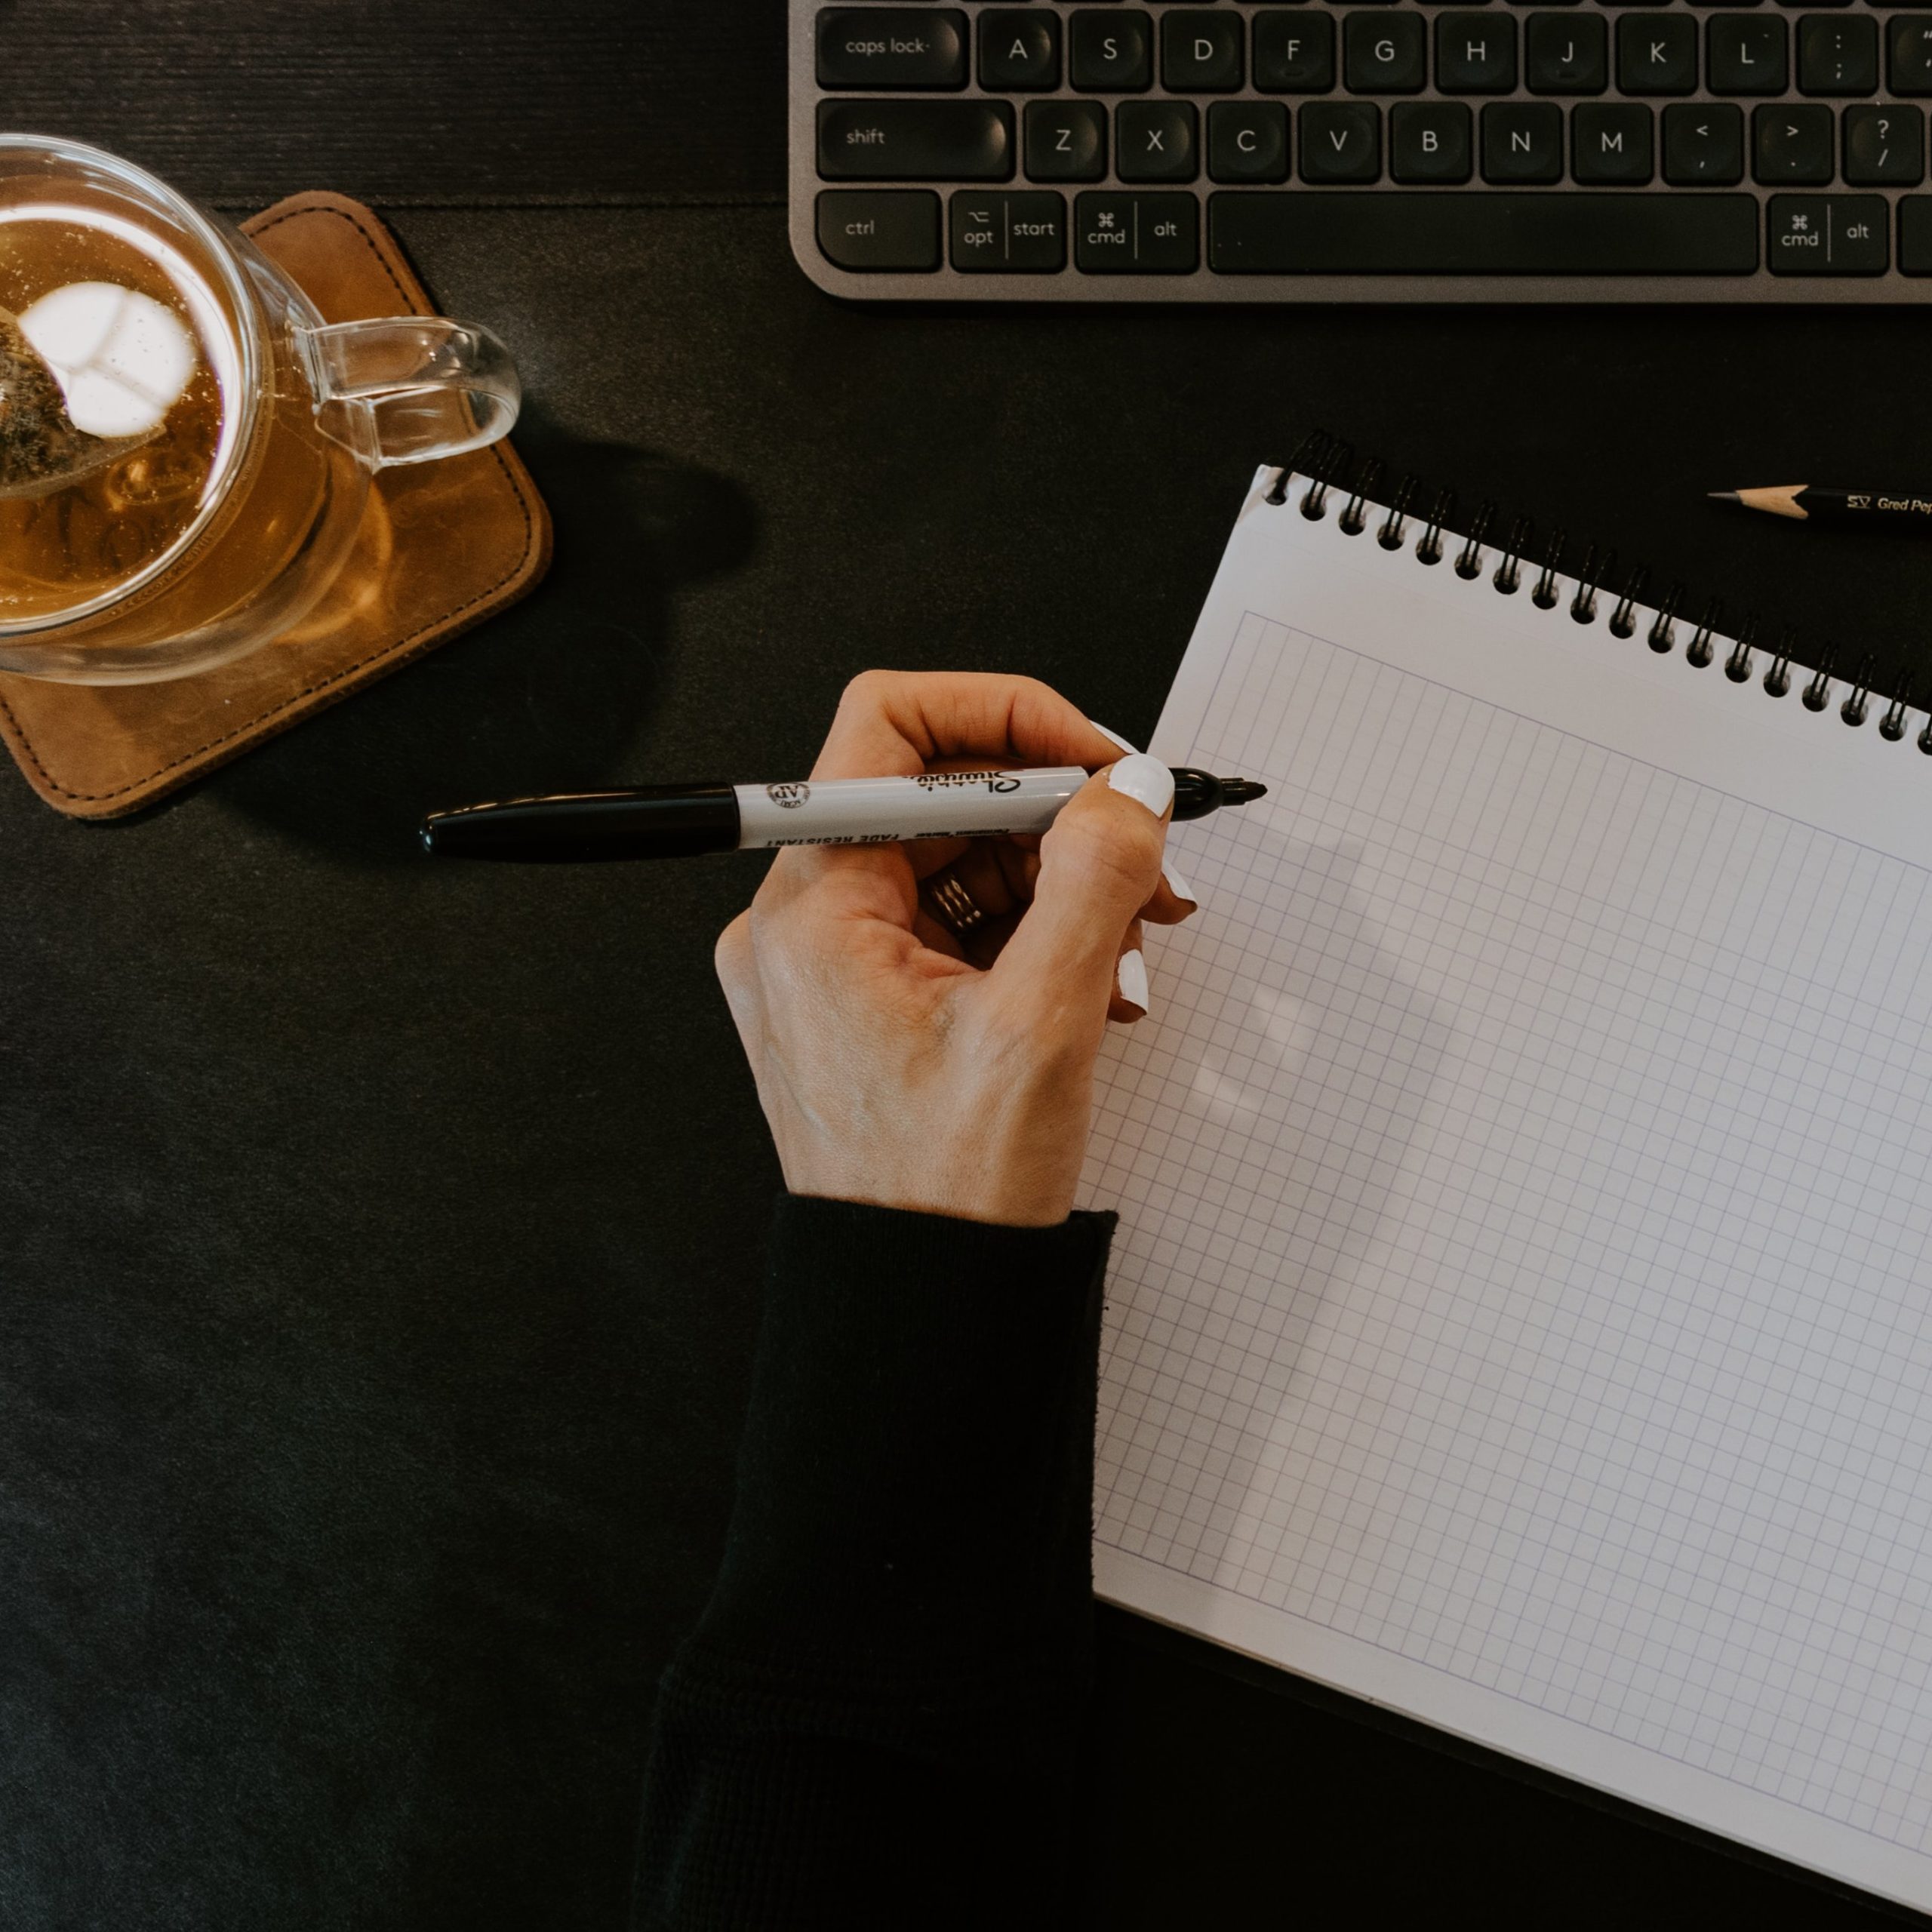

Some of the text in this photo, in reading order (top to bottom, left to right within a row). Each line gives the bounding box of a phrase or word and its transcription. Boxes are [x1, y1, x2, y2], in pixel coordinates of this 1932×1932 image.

[845, 38, 924, 57] caps lock
[1009, 38, 1028, 59] A
[1103, 38, 1118, 60] S
[1195, 39, 1214, 60] D
[1287, 39, 1300, 60] F
[1374, 40, 1395, 62] G
[1467, 41, 1485, 61] H
[1561, 42, 1574, 63] J
[1651, 42, 1666, 63] K
[1741, 43, 1755, 64] L
[847, 128, 884, 144] shift
[1055, 129, 1072, 151] Z
[1878, 119, 1889, 140] ?
[1147, 130, 1164, 151] X
[1237, 130, 1256, 152] C
[1330, 131, 1348, 151] V
[1423, 131, 1438, 152] B
[1512, 131, 1531, 152] N
[1601, 132, 1623, 152] M
[845, 220, 875, 235] ctrl
[1014, 223, 1054, 236] start
[1088, 229, 1125, 245] cmd
[1154, 221, 1177, 236] alt
[1847, 223, 1869, 238] alt
[964, 231, 993, 247] opt
[1781, 231, 1819, 247] cmd
[774, 785, 798, 798] AP
[909, 769, 1024, 793] Sharpie
[766, 832, 900, 847] FADE RESISTANT
